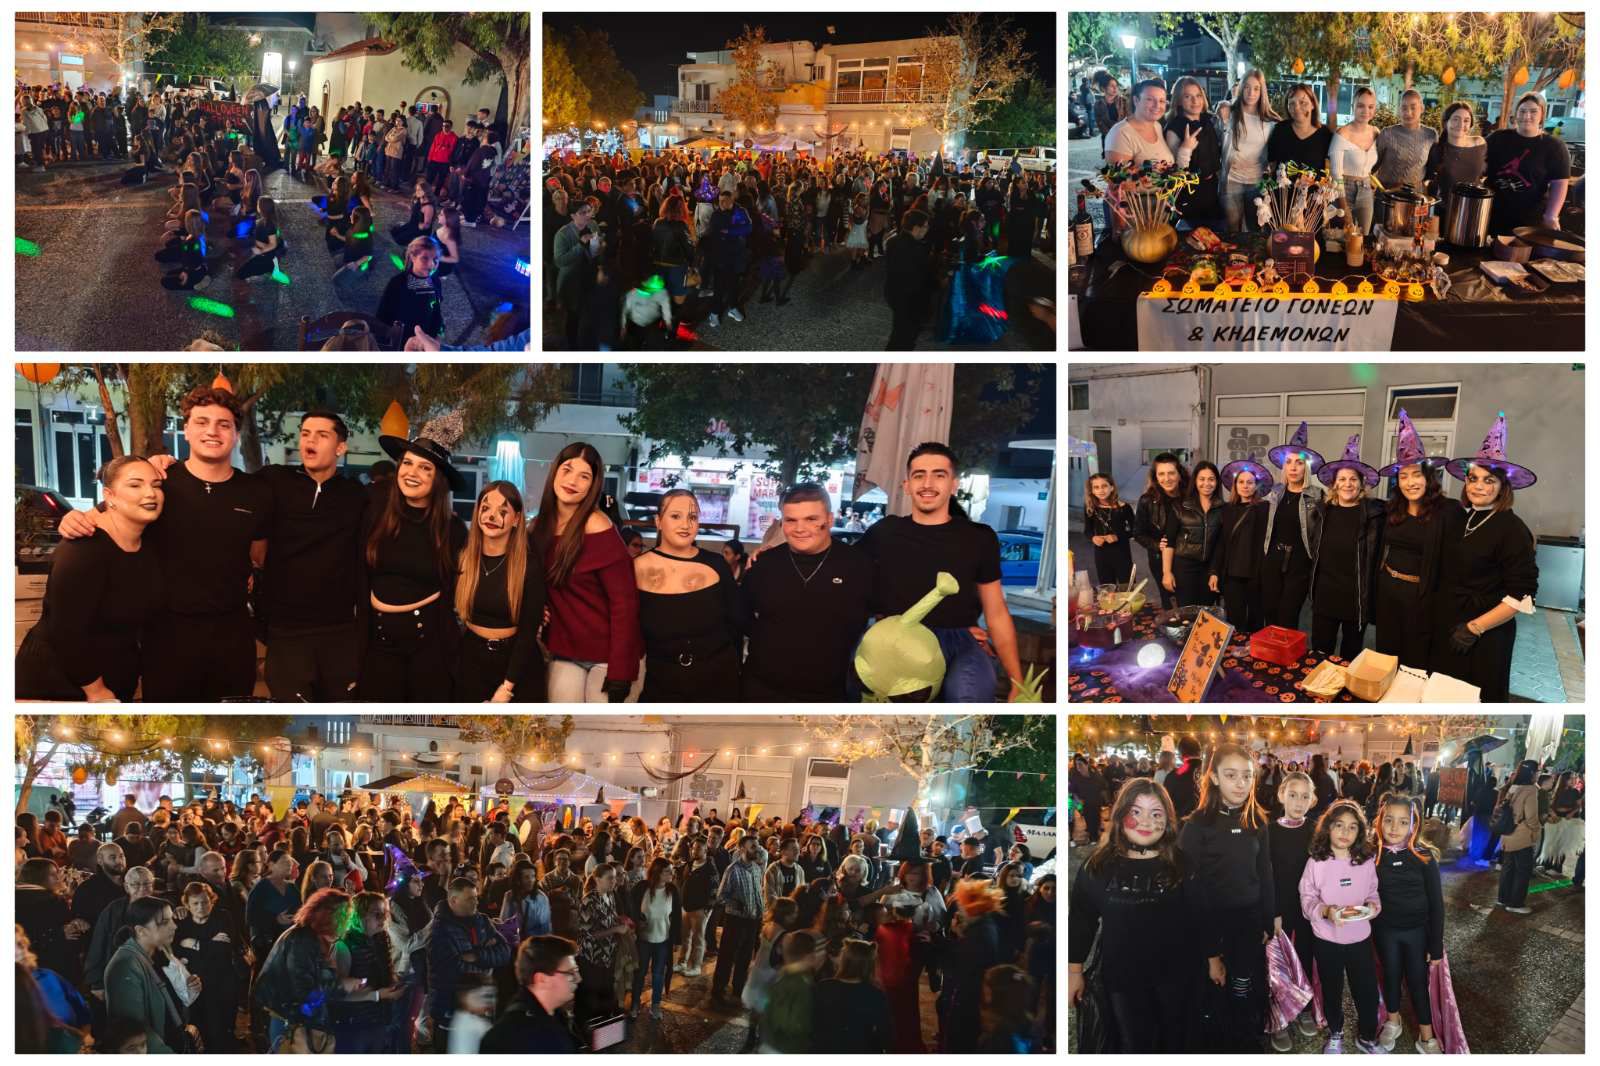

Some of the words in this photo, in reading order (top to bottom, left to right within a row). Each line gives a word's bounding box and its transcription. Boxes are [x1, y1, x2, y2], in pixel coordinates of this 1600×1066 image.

[1162, 297, 1280, 315] ΣΩΜΑΤΕΙΟ
[1287, 299, 1374, 316] ΓΟΝΕΩΝ
[1187, 326, 1204, 342] &
[1212, 326, 1350, 343] ΚΗΔΕΜΟΝΩΝ
